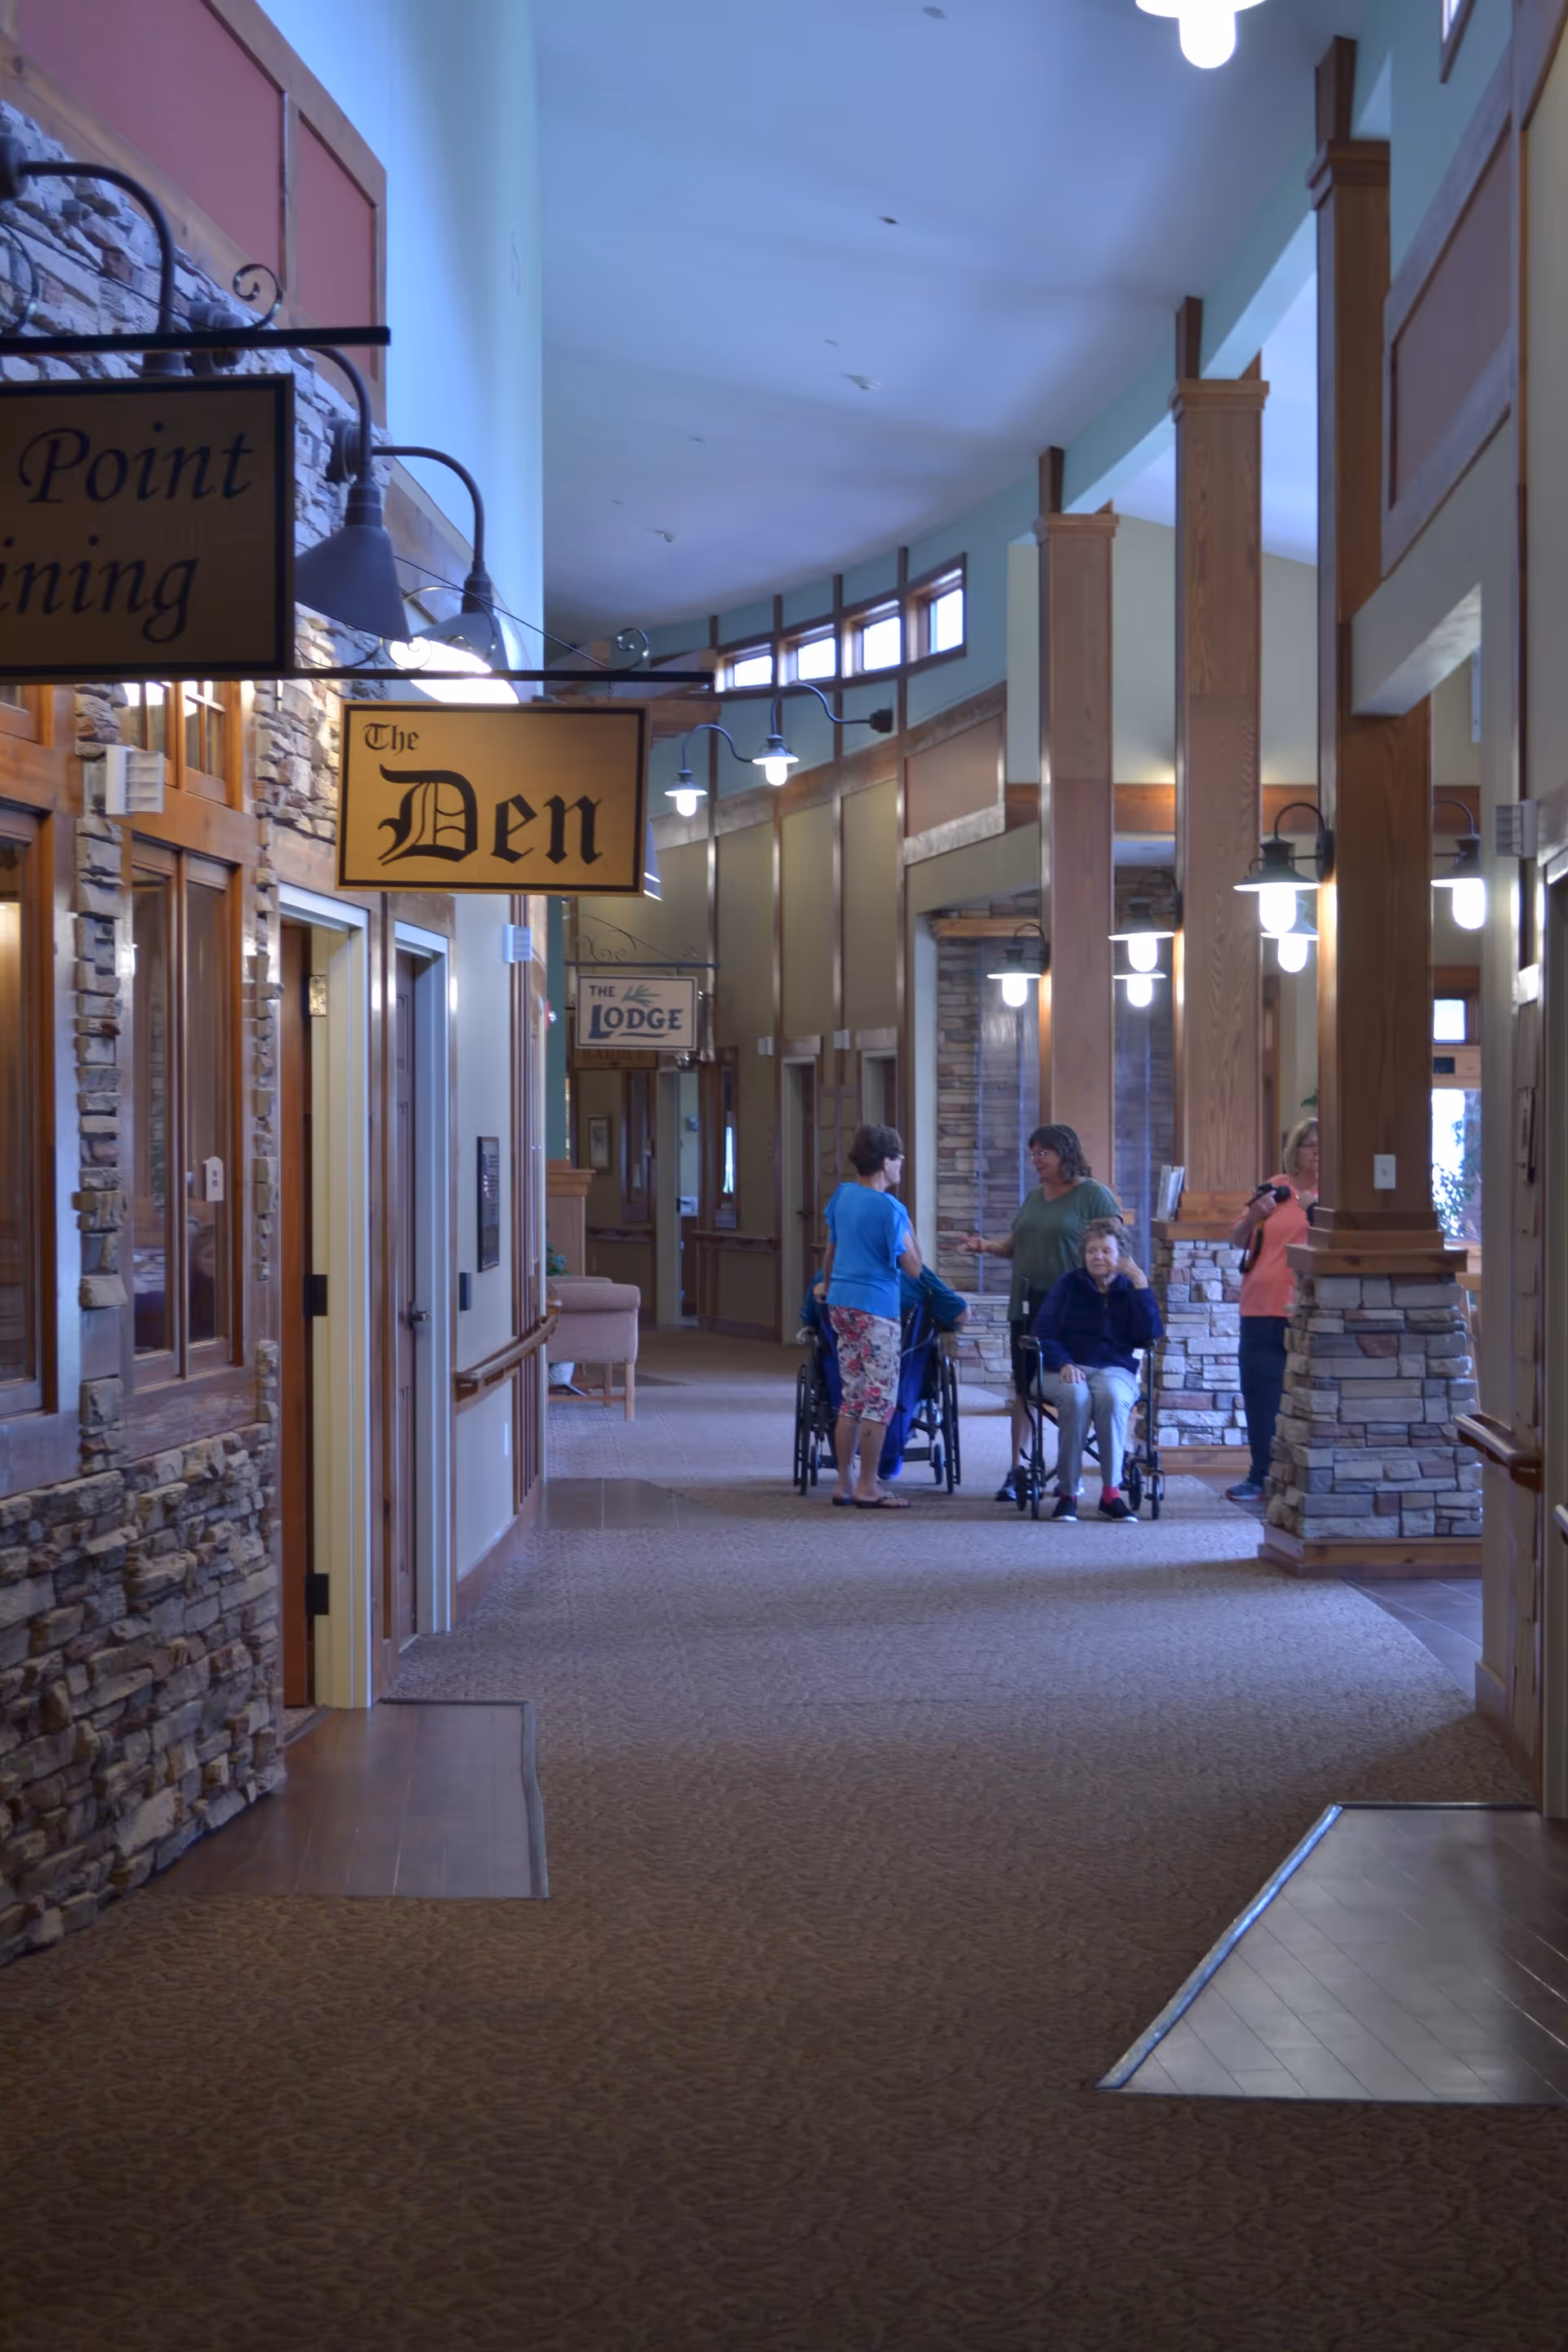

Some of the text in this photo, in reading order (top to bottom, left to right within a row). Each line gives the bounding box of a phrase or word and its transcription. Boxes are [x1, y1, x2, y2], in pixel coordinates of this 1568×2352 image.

[18, 421, 254, 503] Point
[362, 722, 419, 756] The
[376, 764, 604, 866] Den
[588, 985, 616, 998] THE
[588, 1004, 684, 1040] LODGE
